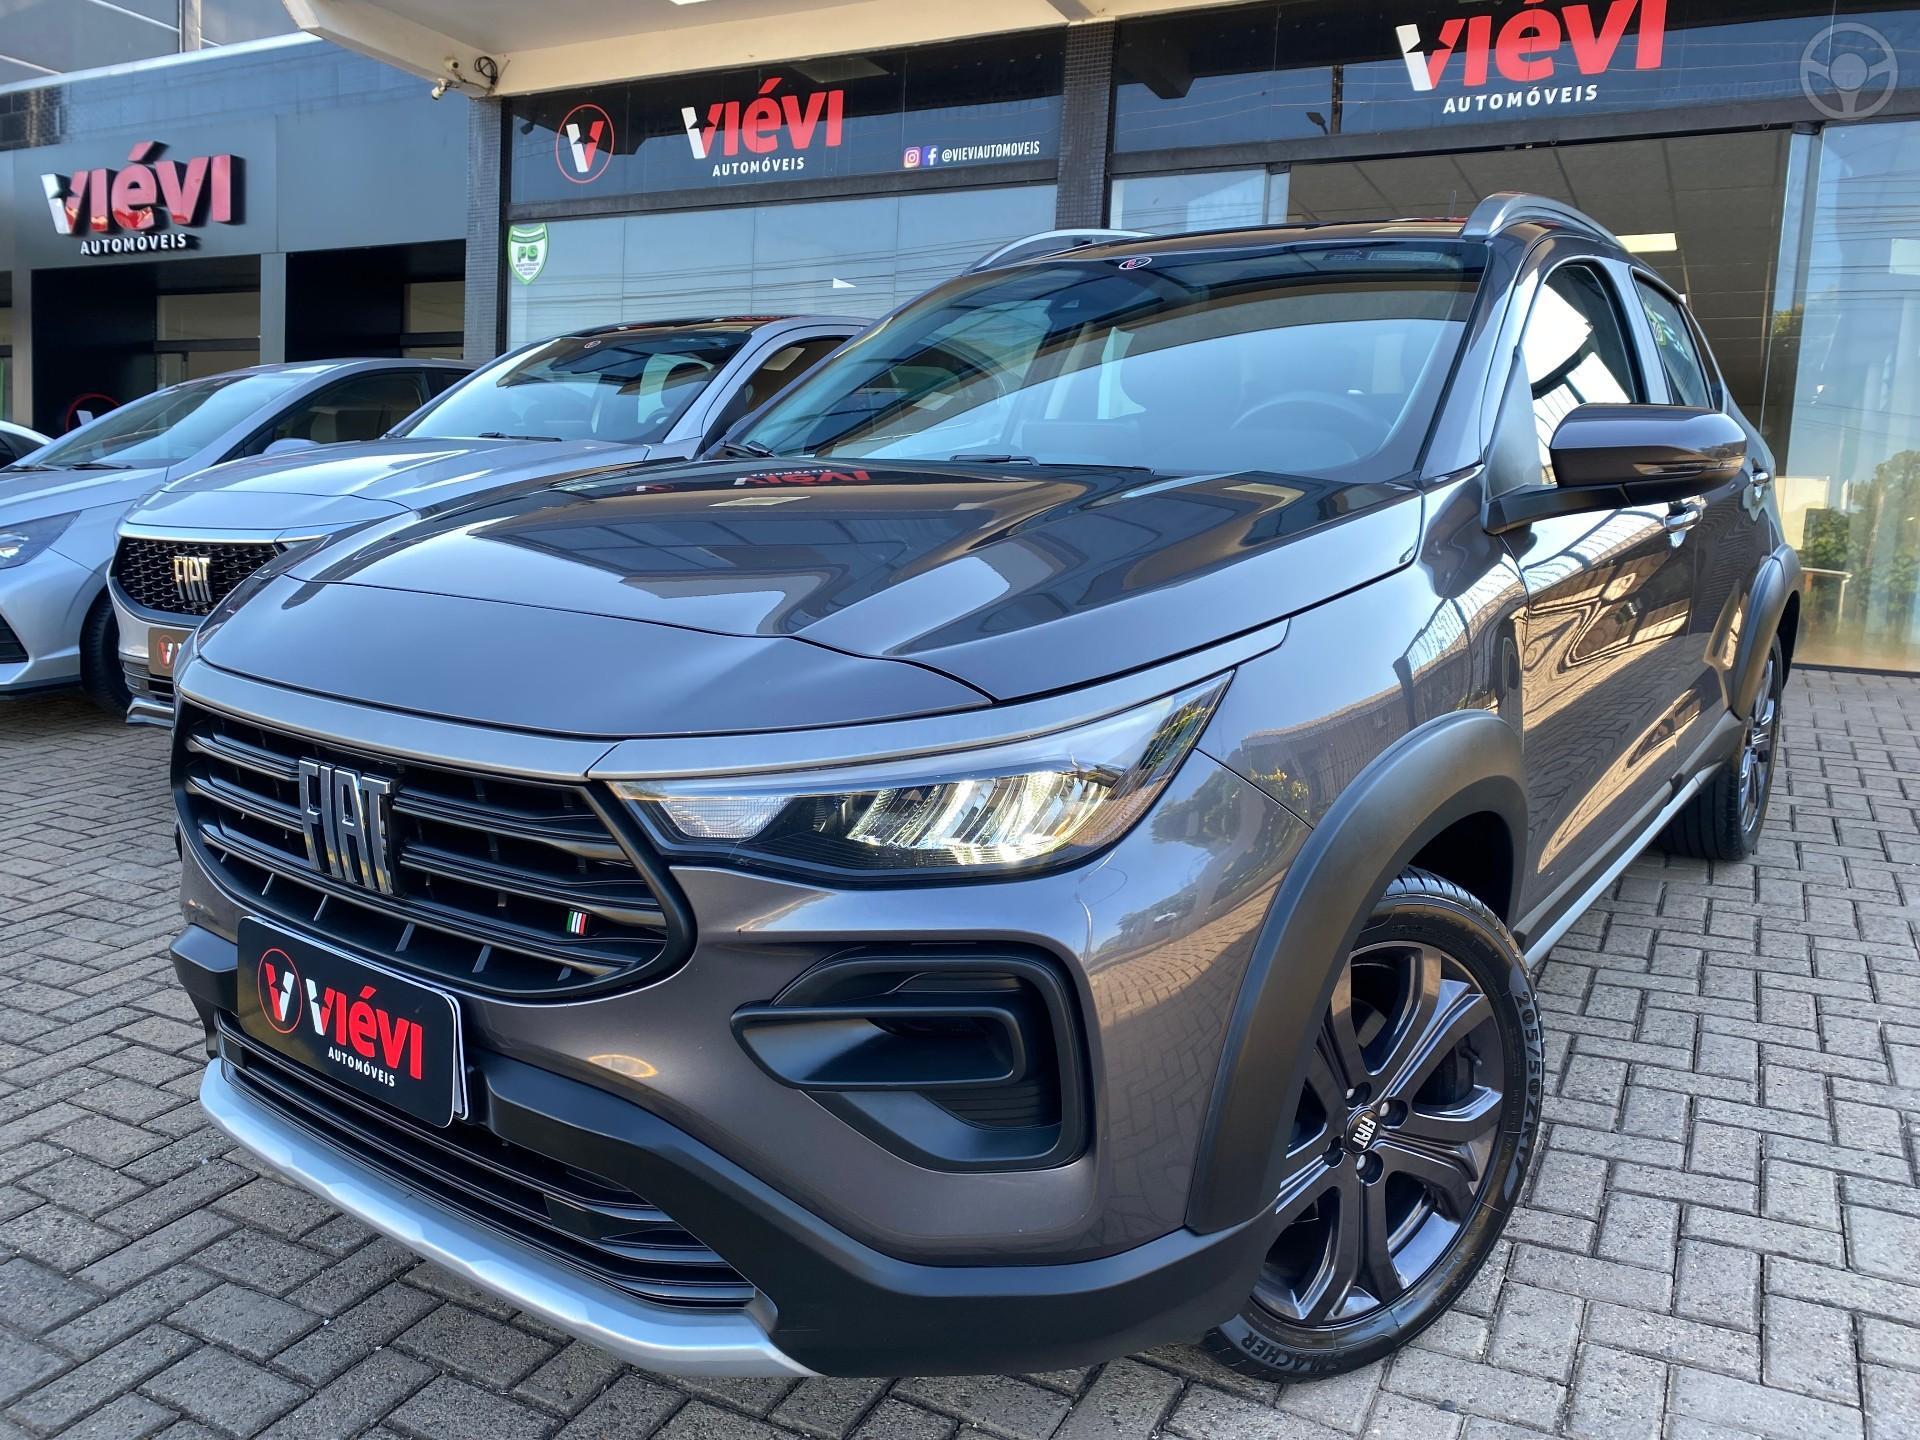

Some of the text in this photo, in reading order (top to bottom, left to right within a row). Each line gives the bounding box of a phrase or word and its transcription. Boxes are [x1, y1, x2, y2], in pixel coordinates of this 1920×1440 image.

[1443, 85, 1598, 114] AUTOMÓVEIS
[712, 157, 805, 177] AUTOMÓVEIS
[941, 140, 1041, 163] @VIEVIAUTOMOVEIS
[80, 232, 187, 255] AUTOMÓVEIS
[173, 555, 212, 603] FIAT
[299, 757, 395, 896] FIAT
[328, 1046, 396, 1088] AUTOMÓVEIS
[1352, 1115, 1377, 1149] FIAT
